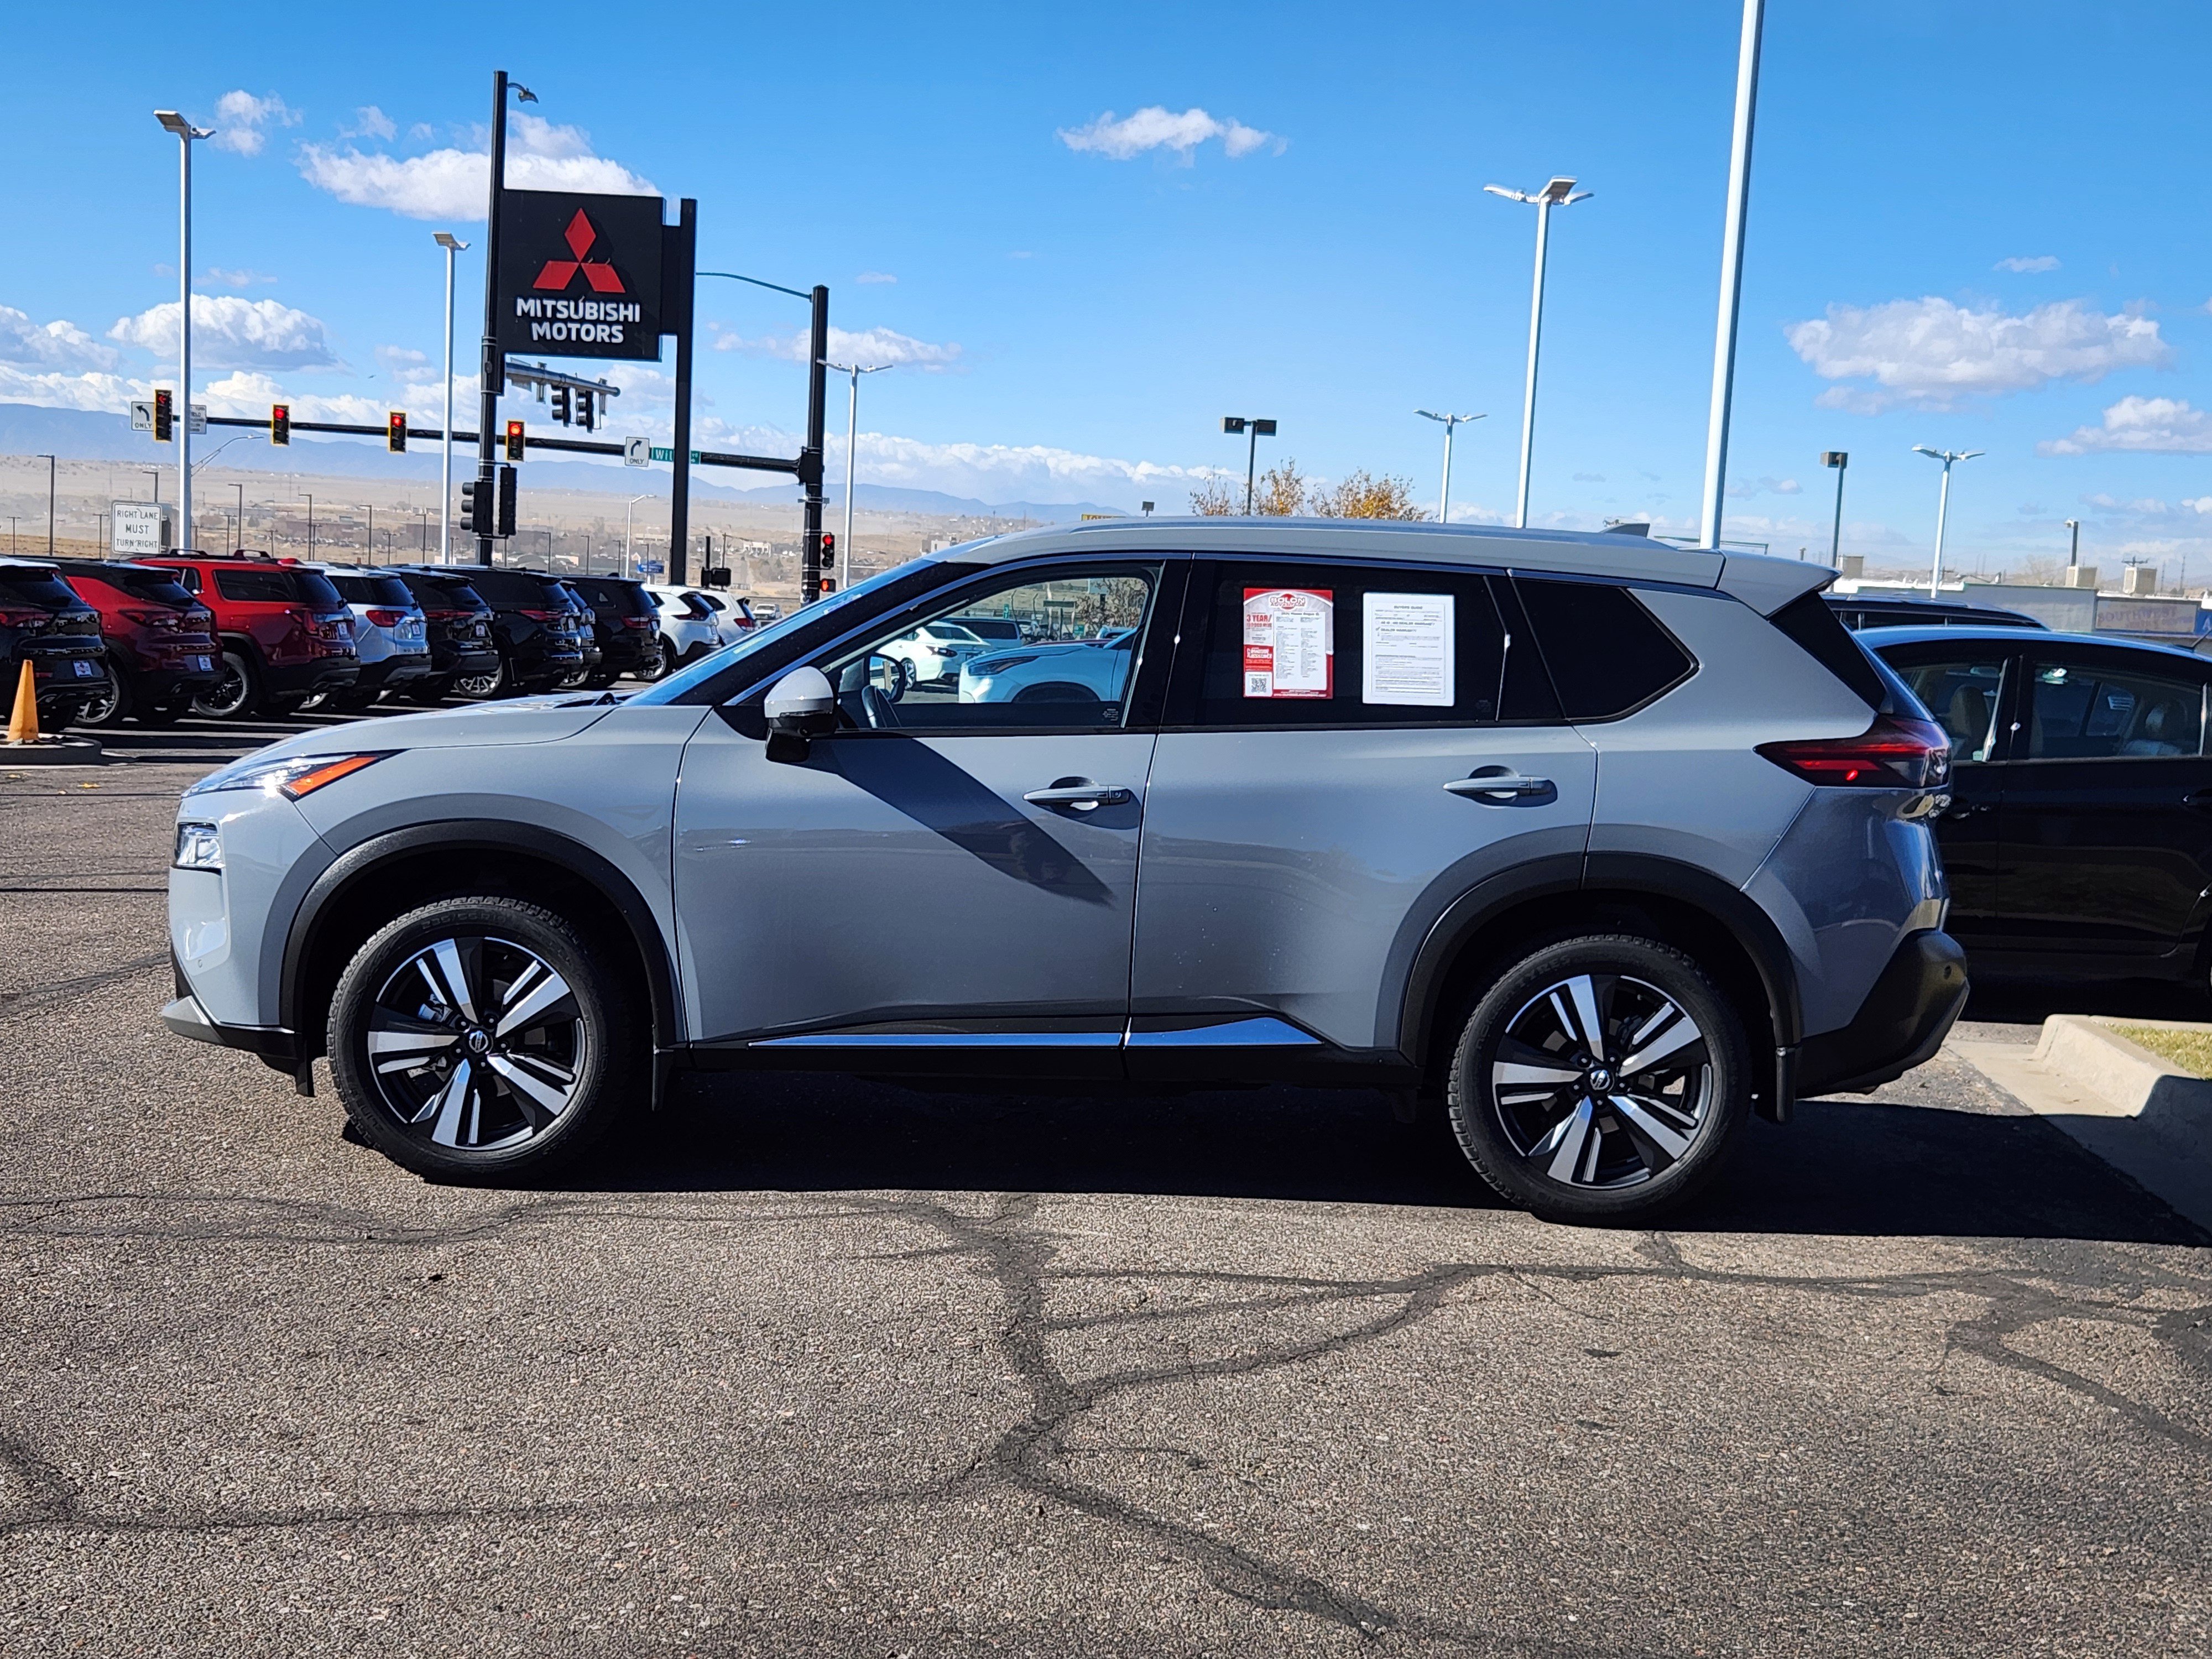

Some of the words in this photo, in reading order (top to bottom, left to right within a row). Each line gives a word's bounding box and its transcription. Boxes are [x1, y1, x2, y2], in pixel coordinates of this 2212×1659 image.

[517, 297, 640, 322] MITSUBISHI
[531, 322, 624, 343] MOTORS
[655, 449, 673, 461] Wil
[117, 510, 138, 519] RIGHT
[140, 510, 159, 520] LANE
[126, 524, 149, 534] MUST
[116, 538, 134, 547] TURN
[137, 540, 158, 549] RIGHT
[1246, 614, 1251, 622] 3
